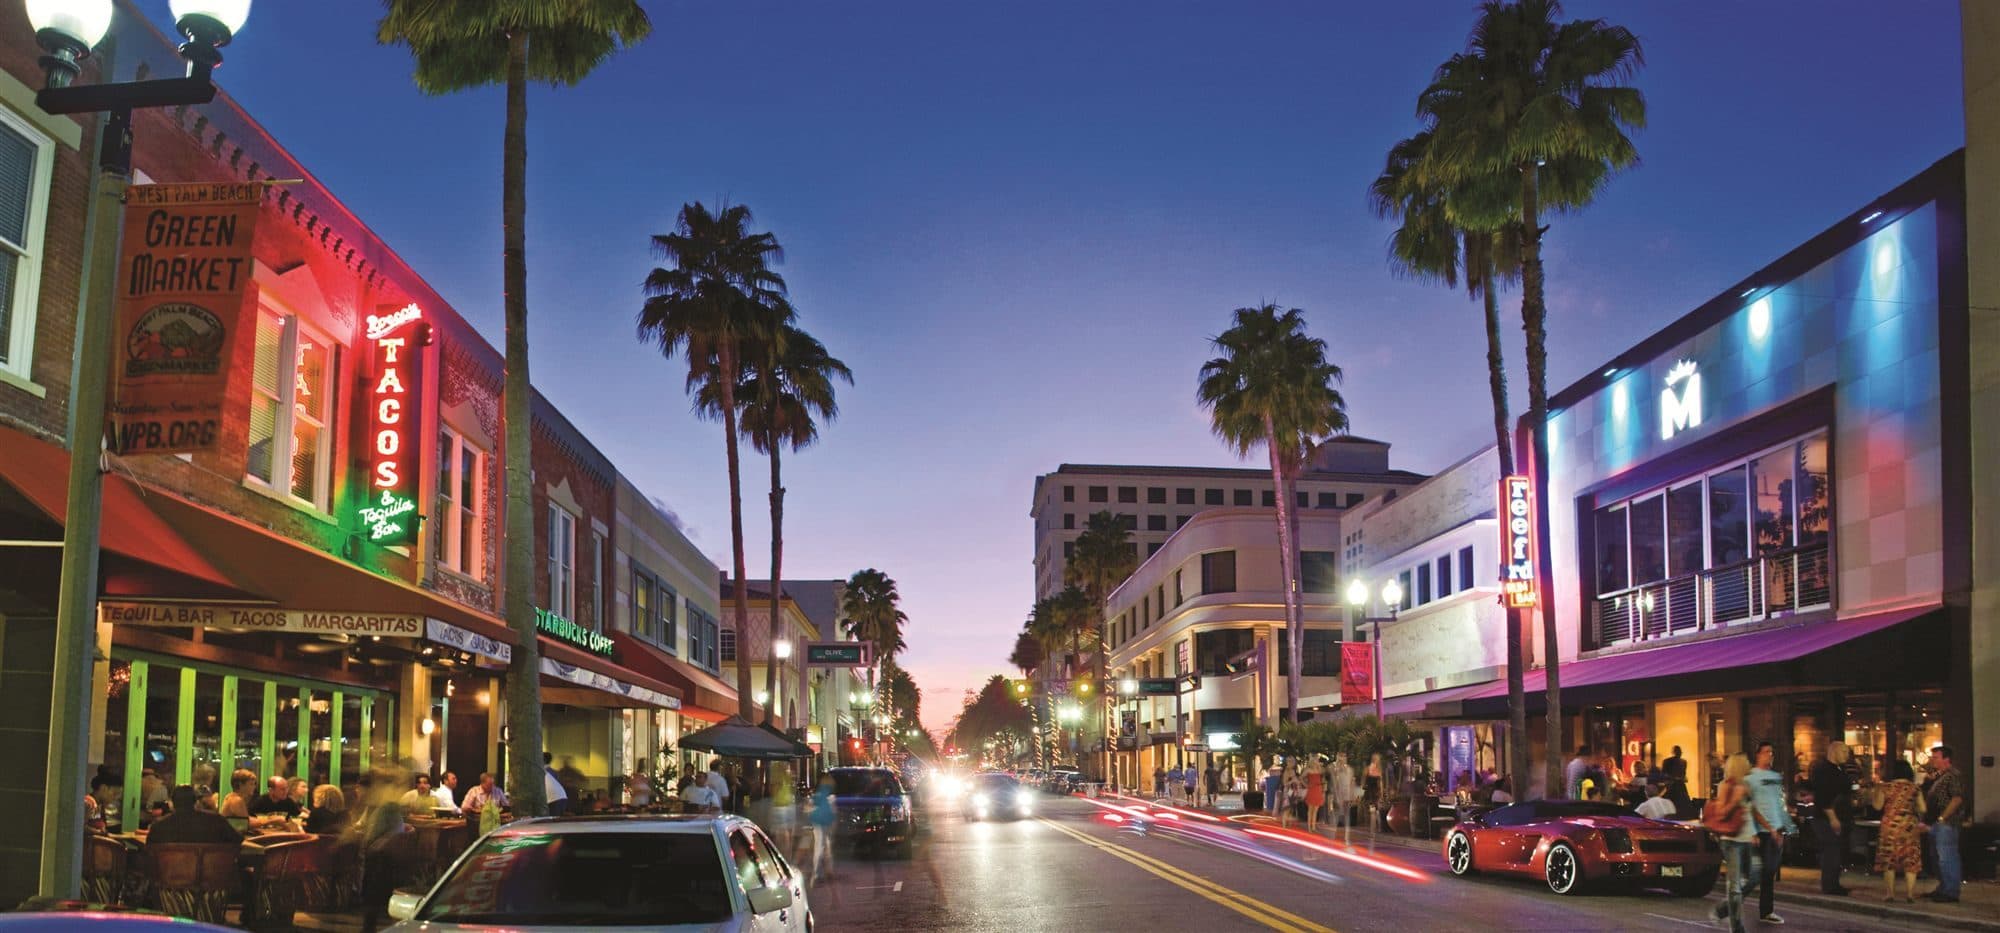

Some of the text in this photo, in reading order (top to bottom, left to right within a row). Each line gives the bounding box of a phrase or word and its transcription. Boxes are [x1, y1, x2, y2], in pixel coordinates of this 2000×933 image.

[137, 183, 253, 202] WEST PALM BEACH
[145, 209, 237, 248] GREEN
[129, 254, 244, 296] MARKET
[376, 337, 405, 487] TACOS
[1661, 371, 1702, 441] M
[358, 497, 415, 526] Tequila
[381, 490, 396, 506] &
[371, 520, 404, 539] Bar
[102, 604, 418, 633] TEQUILA BAR TACOS MARGARITAS
[534, 606, 588, 647] STARBUCKS
